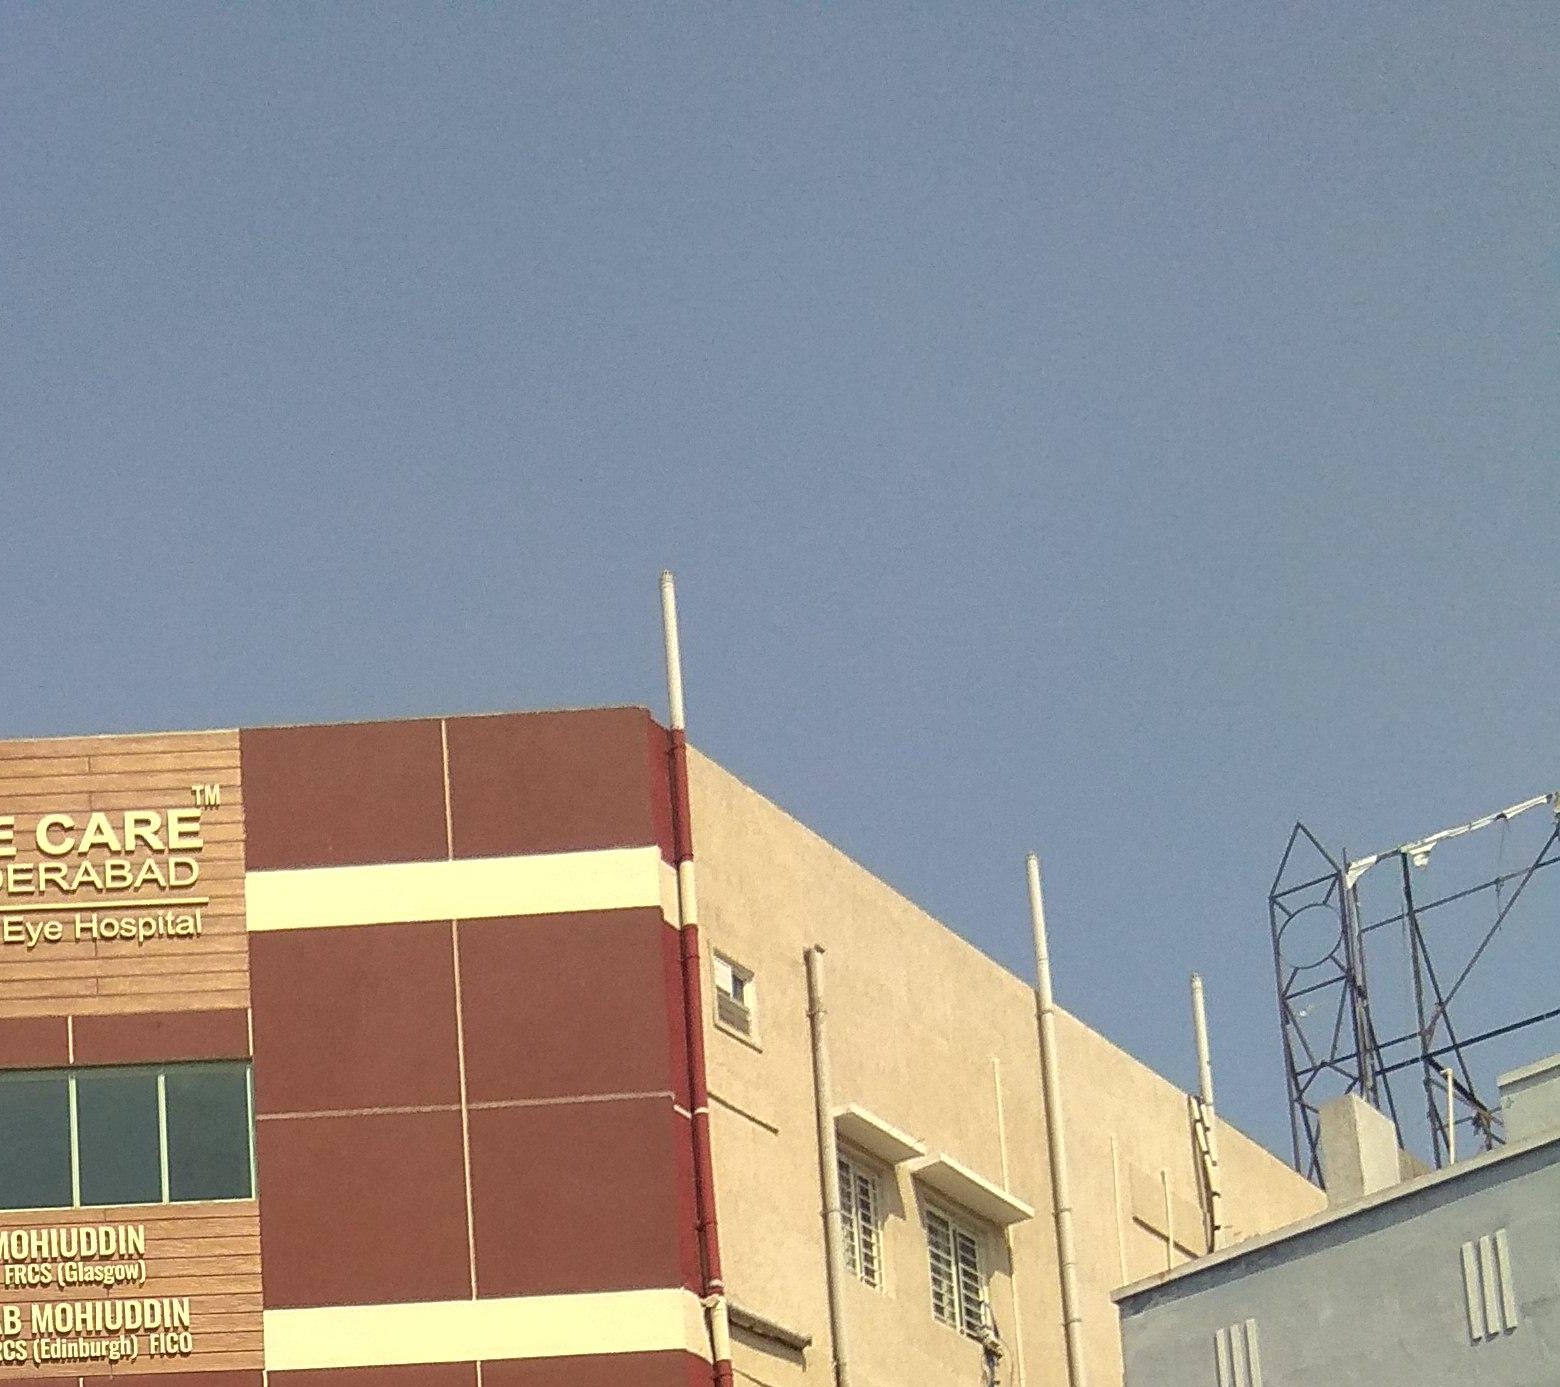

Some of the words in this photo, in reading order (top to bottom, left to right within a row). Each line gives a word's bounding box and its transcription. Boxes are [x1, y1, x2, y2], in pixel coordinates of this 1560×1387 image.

[191, 784, 221, 809] TM
[35, 808, 204, 857] CARE
[2, 918, 63, 948] Eye
[73, 908, 203, 940] Hospital
[4, 1261, 52, 1286] FRCS
[57, 1258, 147, 1285] (Glasgow)
[31, 1297, 191, 1334] MOHIUDDIN
[32, 1334, 139, 1361] (Edinburgh)
[148, 1330, 194, 1354] FICO
